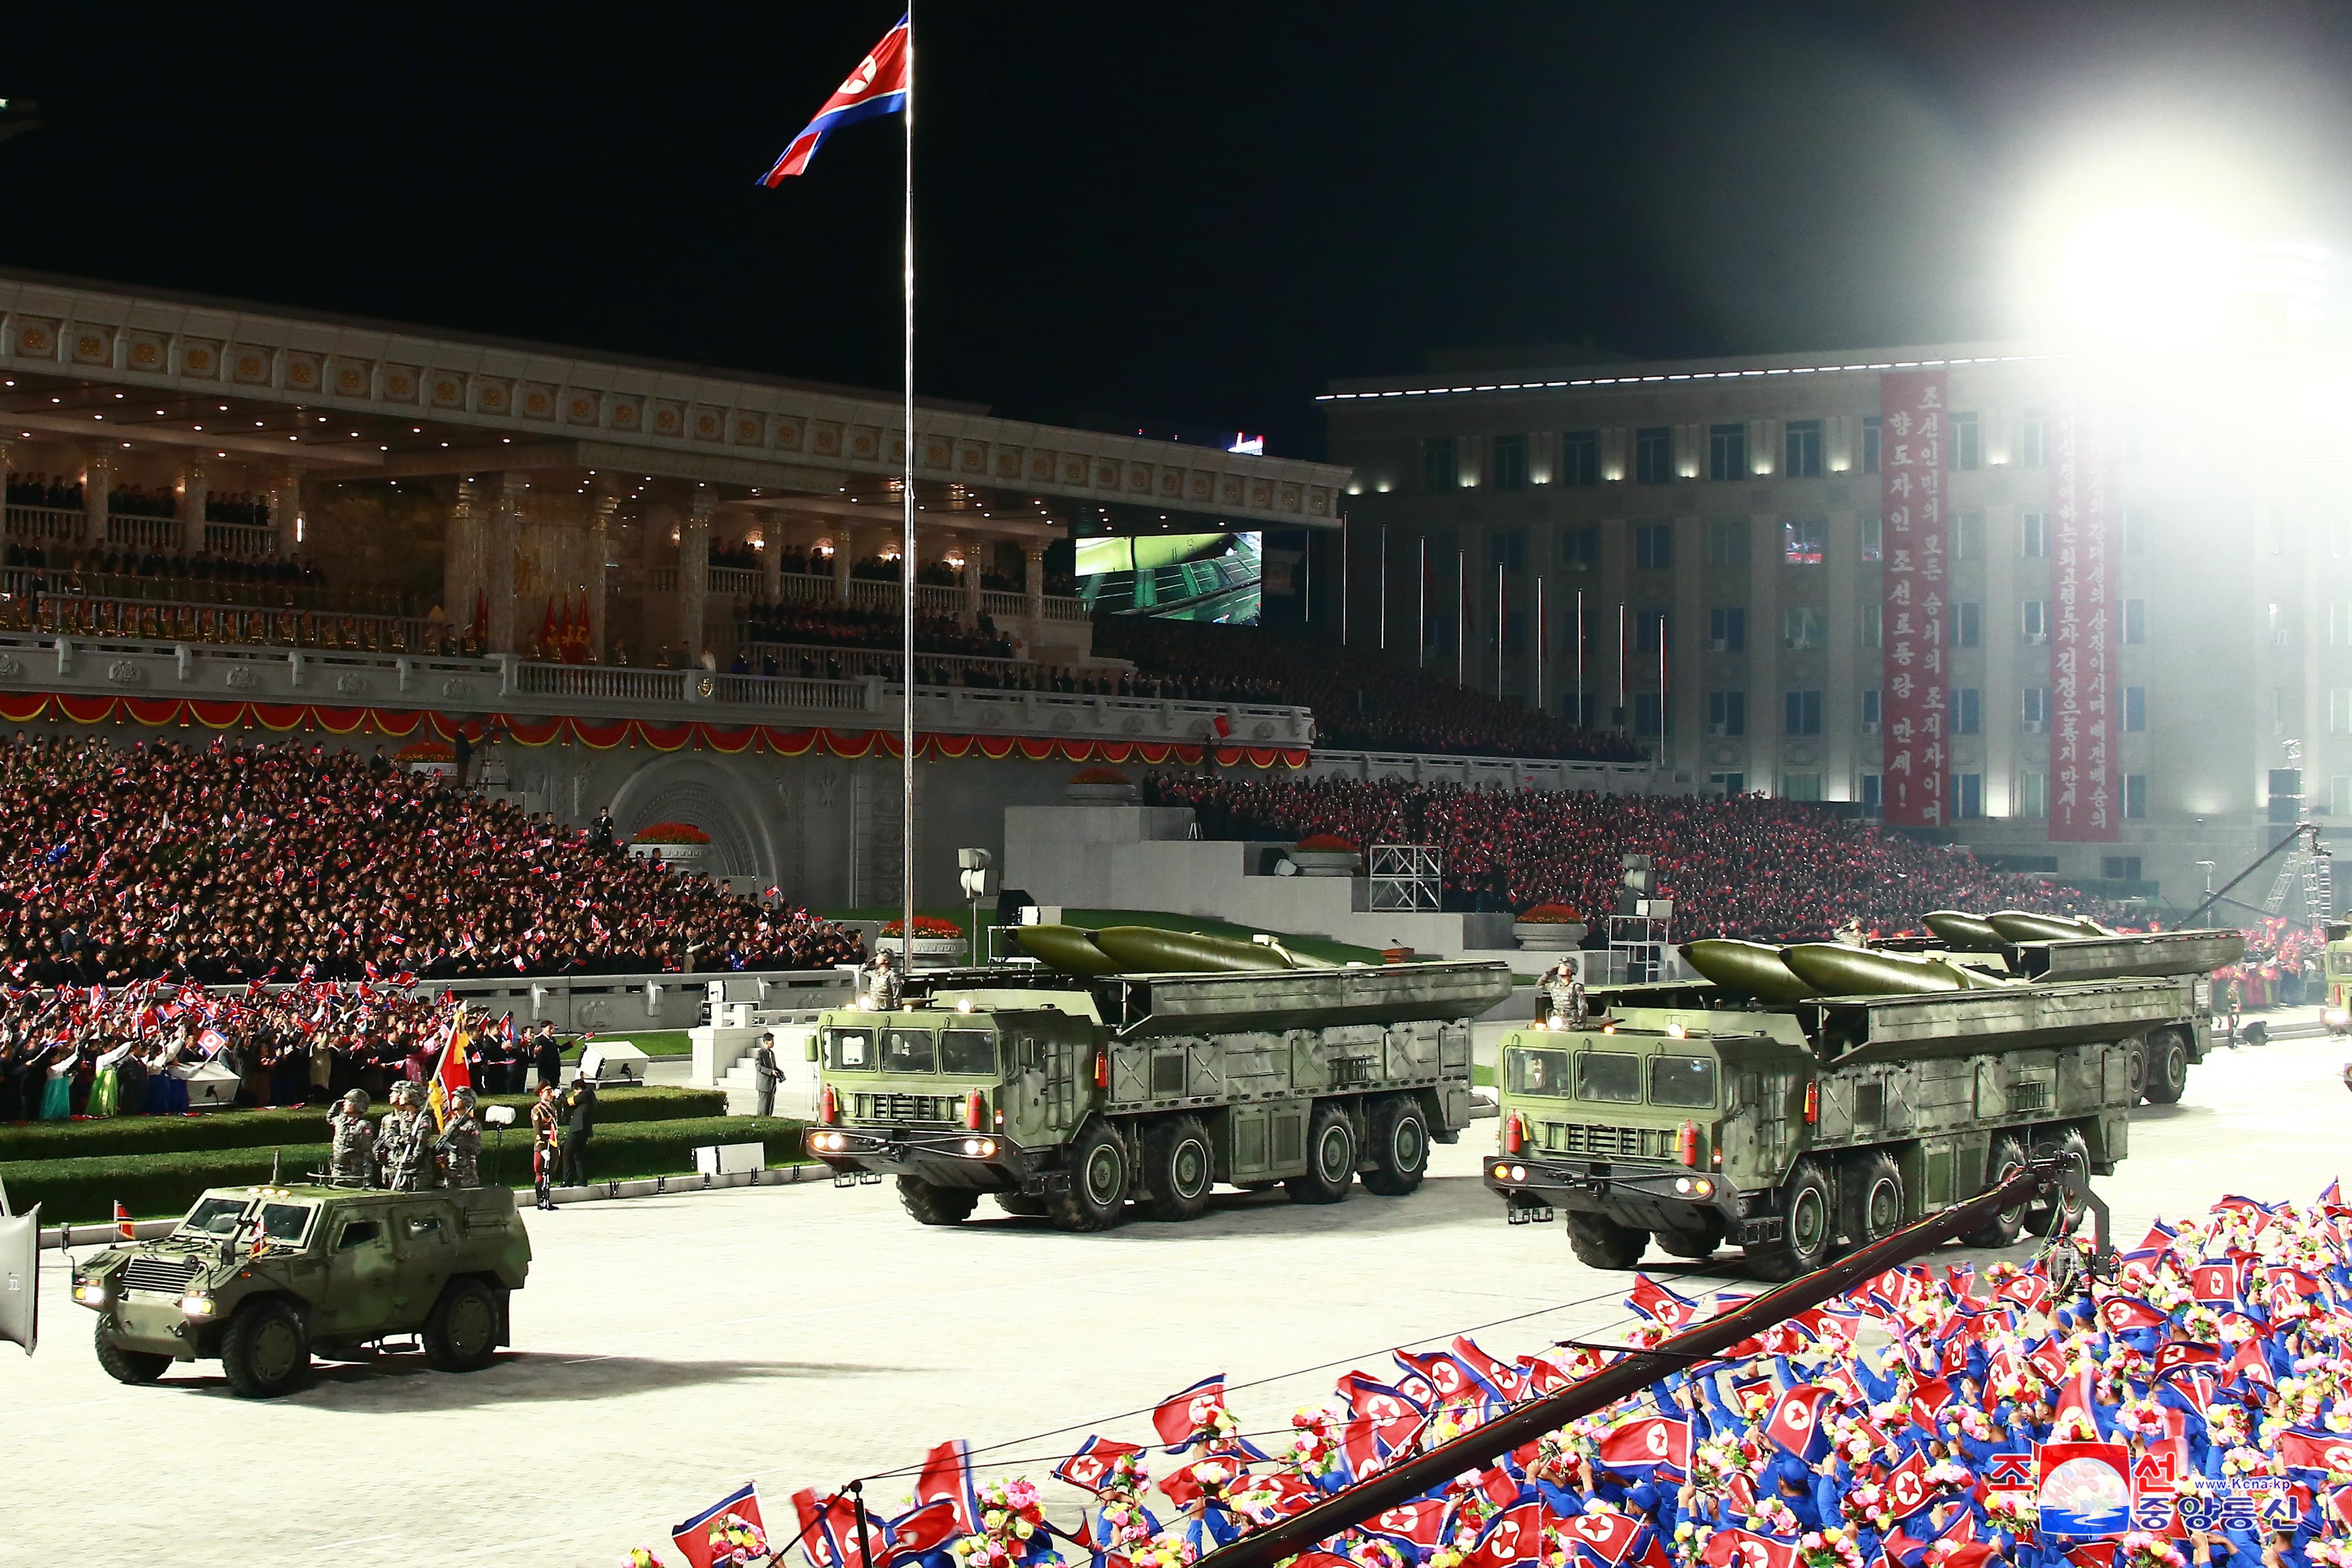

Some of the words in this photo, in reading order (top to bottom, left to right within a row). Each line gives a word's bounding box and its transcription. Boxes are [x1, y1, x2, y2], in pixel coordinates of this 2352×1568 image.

[1888, 411, 1913, 532] 향도자인
[1917, 387, 1942, 523] 조선인민의
[1922, 535, 1942, 581] 모든
[1888, 550, 1914, 699] 조선로동당
[1921, 591, 1942, 675] 승리의
[1889, 717, 1914, 808] 만세!
[1921, 686, 1945, 826] 조직자이며
[2058, 765, 2080, 825] 만세!
